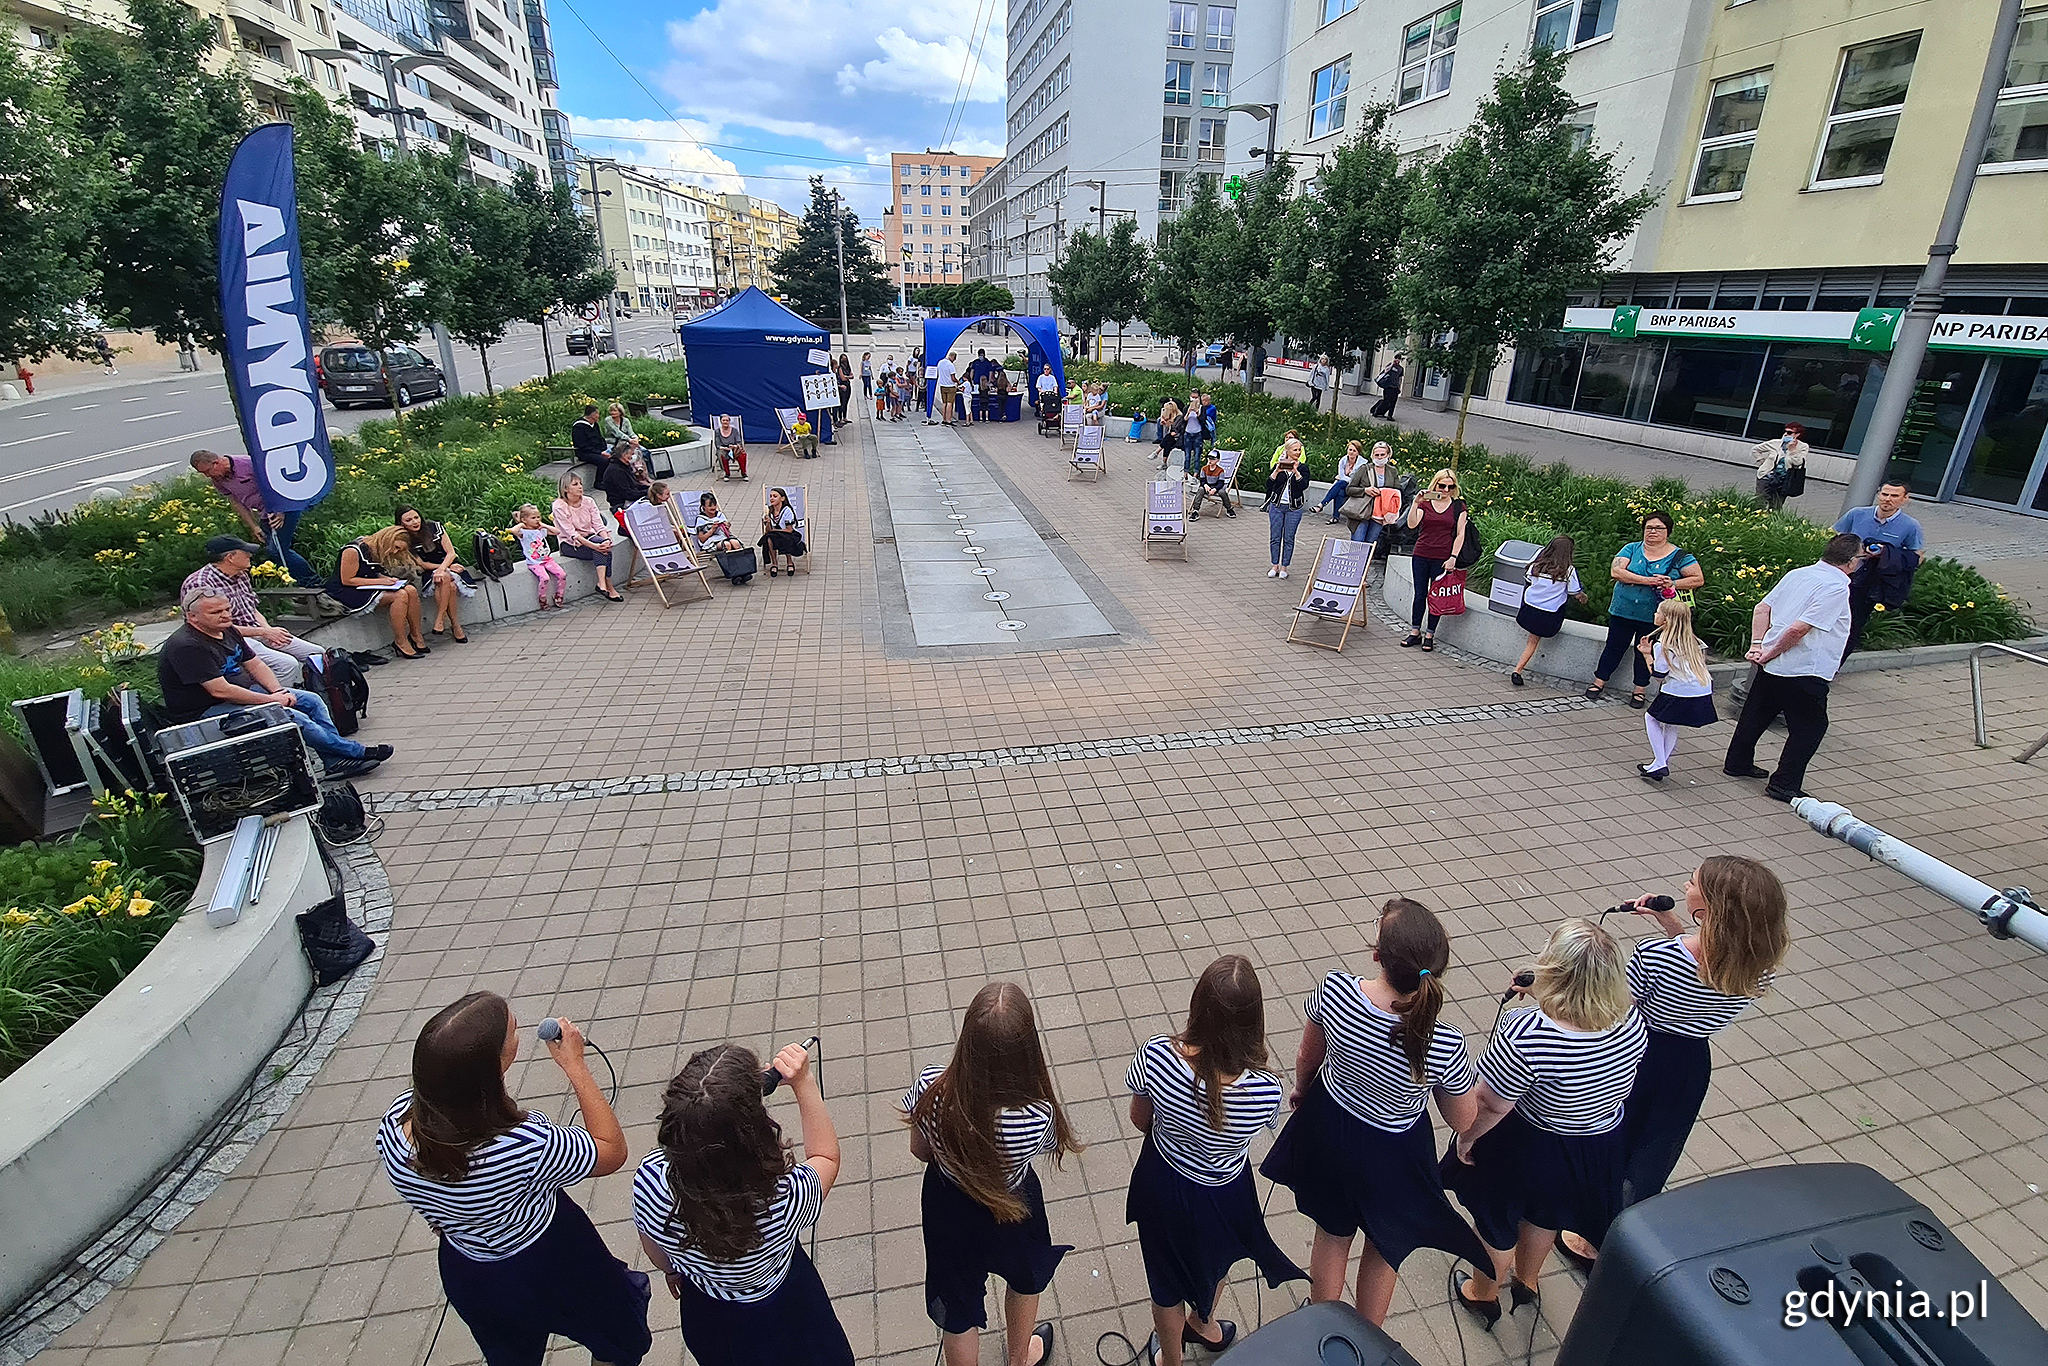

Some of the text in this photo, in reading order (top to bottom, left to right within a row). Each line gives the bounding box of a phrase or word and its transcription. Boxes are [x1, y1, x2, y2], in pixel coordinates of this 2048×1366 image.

[1650, 315, 1737, 329] BNP PARIBAS
[765, 335, 823, 344] www.gdynia.pl
[1932, 322, 2048, 341] NP PARIBA
[236, 199, 328, 501] GDYNIA
